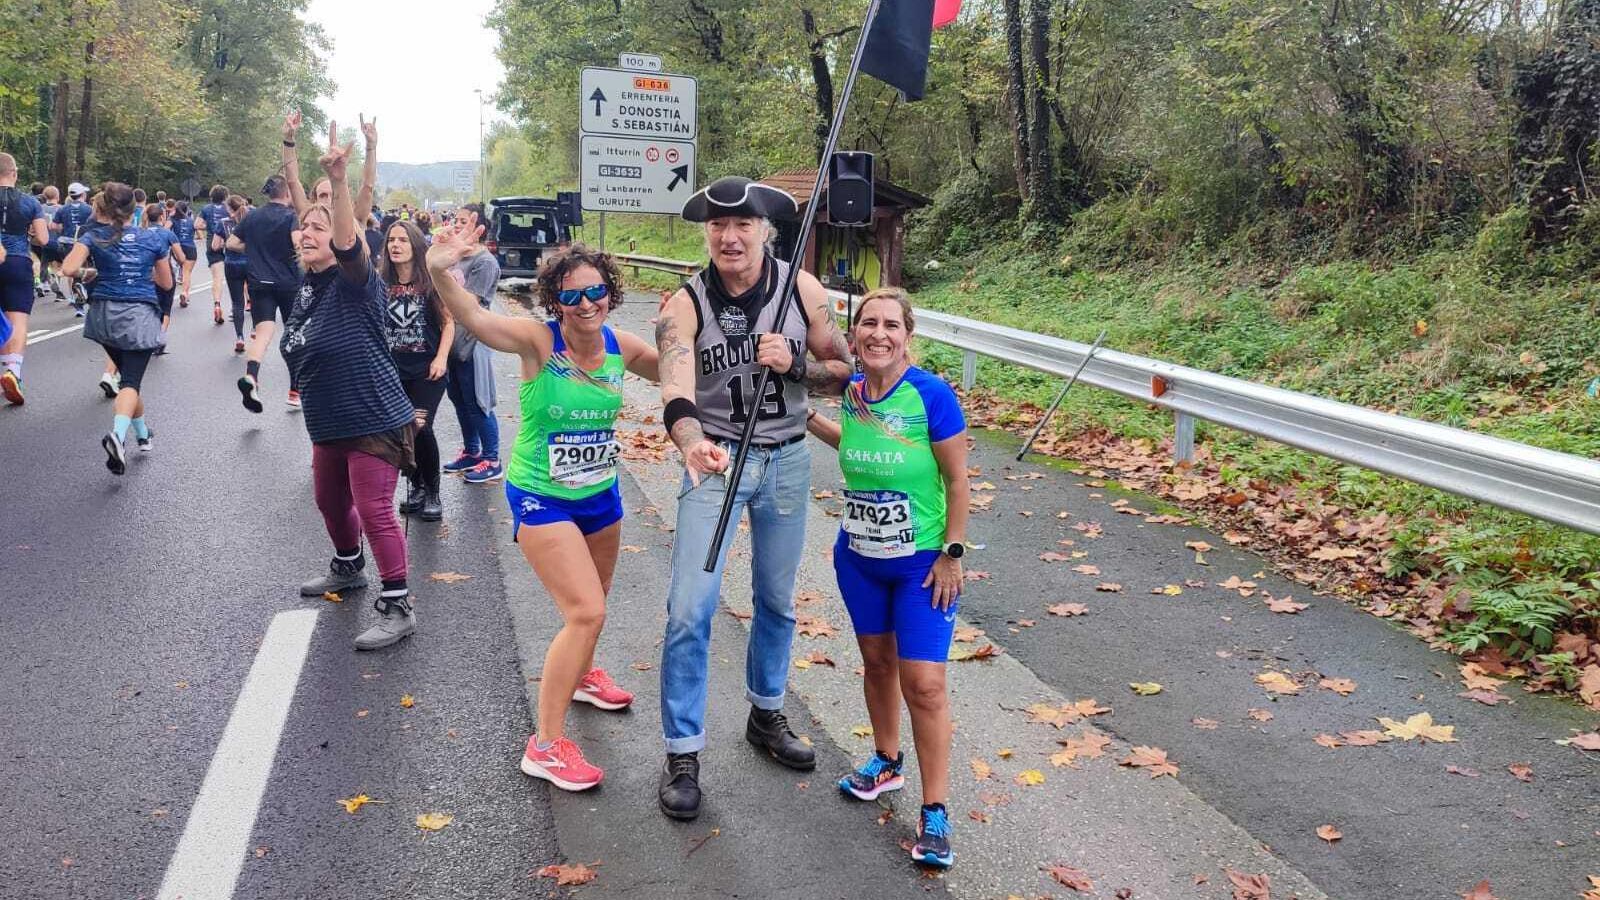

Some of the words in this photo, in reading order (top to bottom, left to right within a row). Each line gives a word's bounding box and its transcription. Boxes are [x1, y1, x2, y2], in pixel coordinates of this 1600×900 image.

[626, 58, 644, 67] 100
[635, 79, 669, 90] GI-636
[621, 91, 680, 104] ERRENTERIA
[619, 105, 681, 120] DONOSTIA
[599, 166, 641, 177] GI-3632
[606, 184, 653, 194] Lanbarren
[598, 197, 641, 207] GURUTZE
[570, 409, 617, 420] SAKAT
[846, 449, 905, 464] SAKATA
[846, 501, 908, 526] 27923
[900, 530, 913, 542] 17
